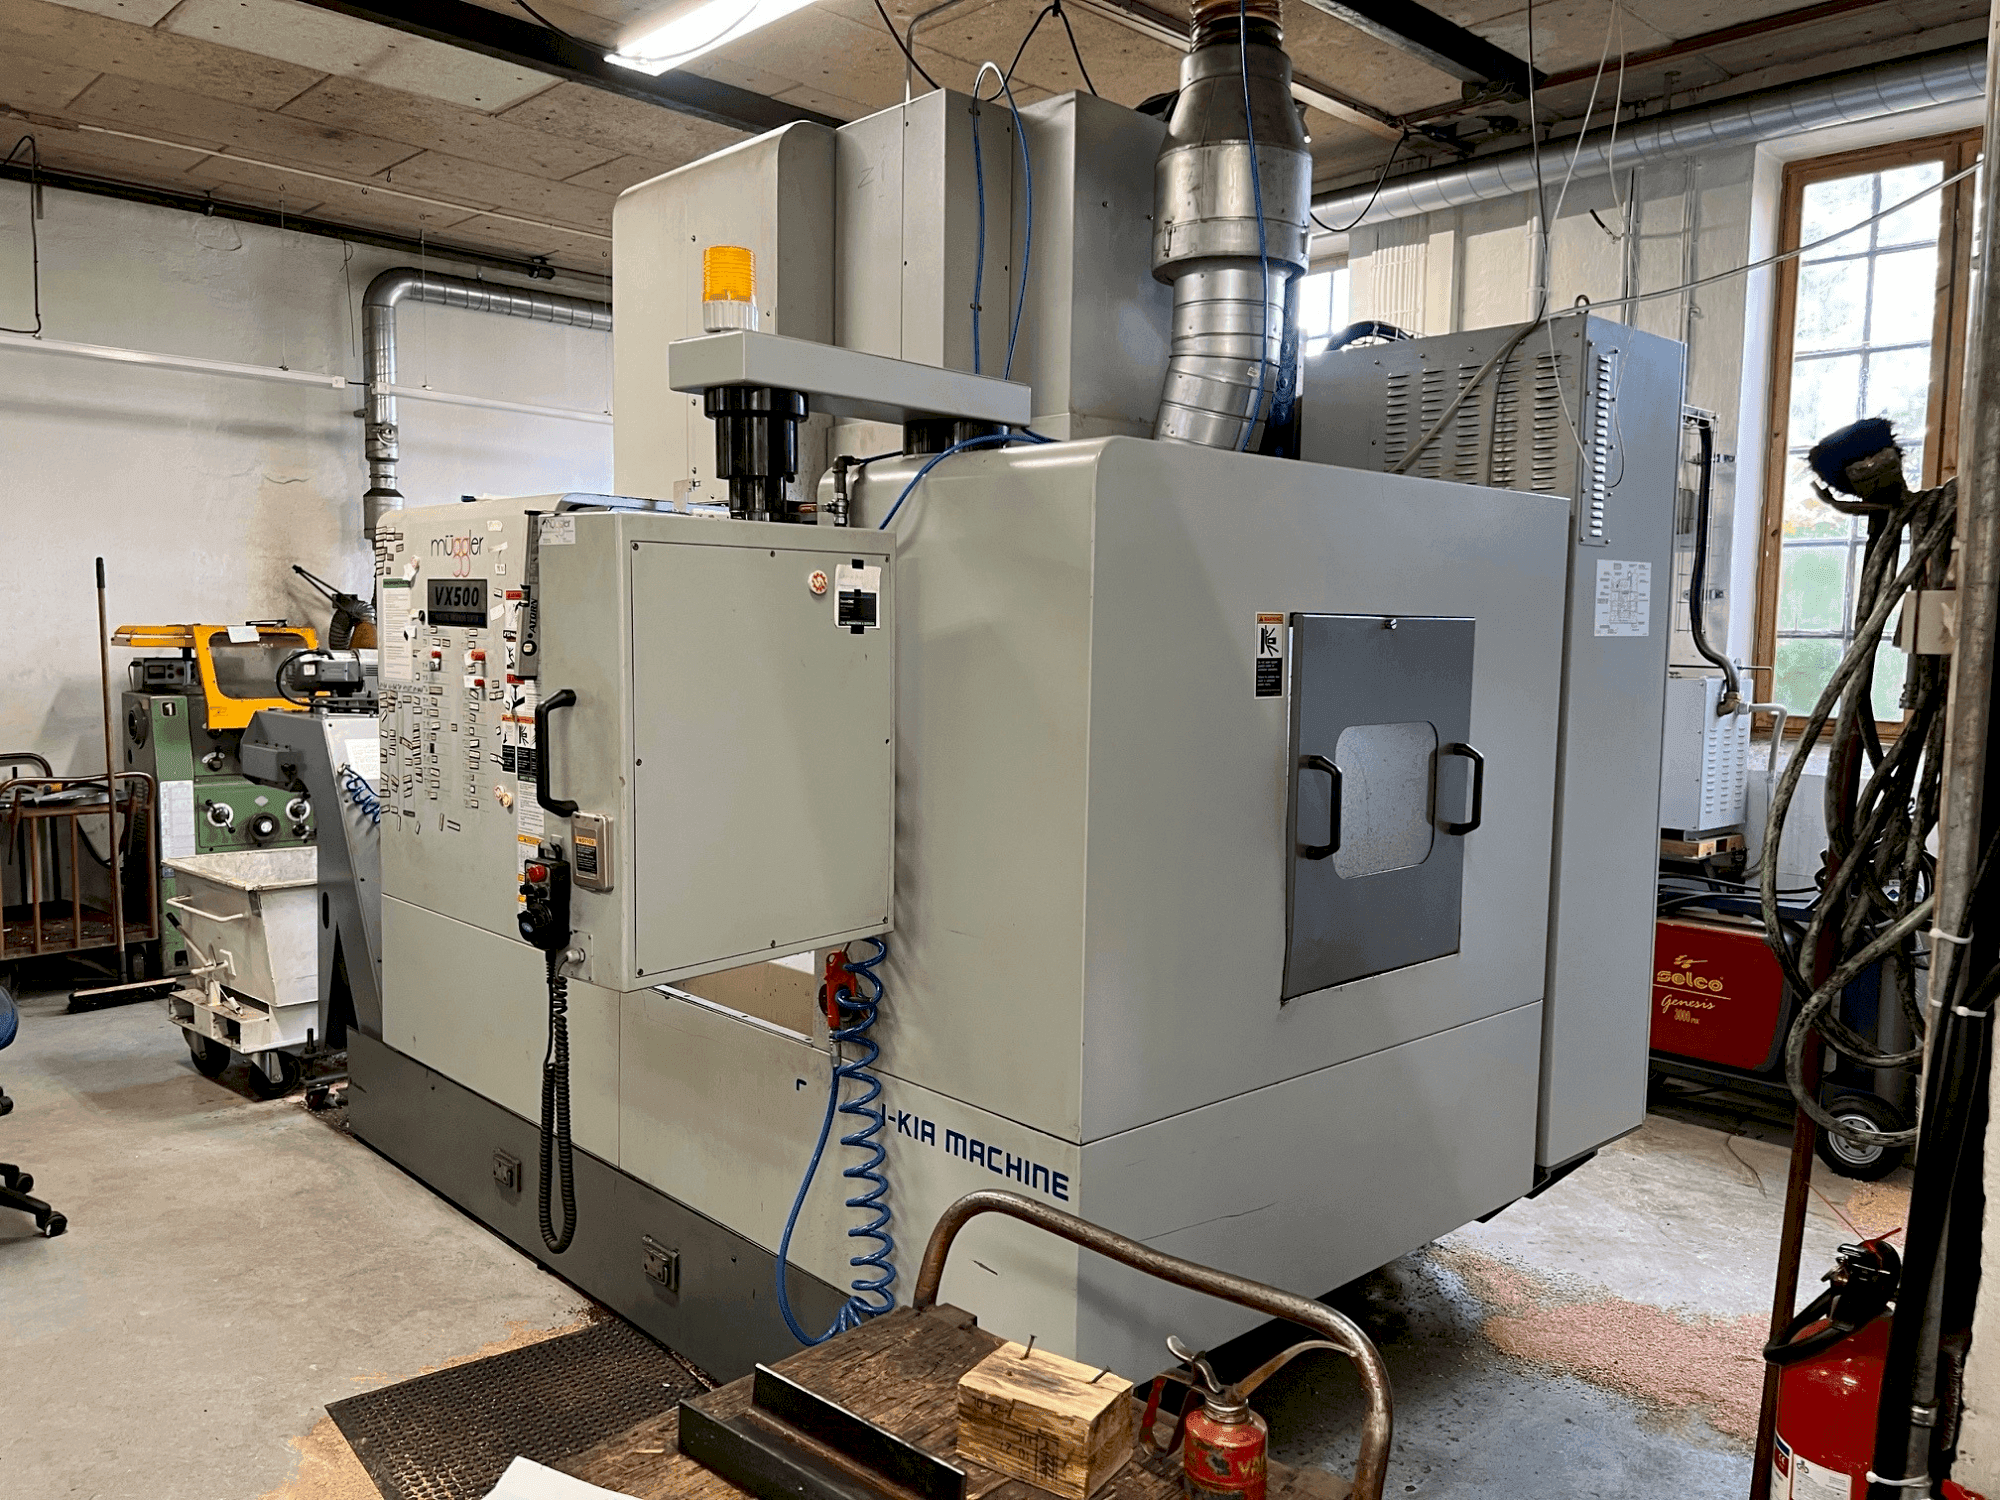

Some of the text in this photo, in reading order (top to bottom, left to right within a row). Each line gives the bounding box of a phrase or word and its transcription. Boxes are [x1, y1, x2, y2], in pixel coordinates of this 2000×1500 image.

[431, 529, 484, 577] müggler
[435, 586, 479, 607] VX500
[529, 599, 538, 634] ATORN
[1661, 994, 1716, 1014] Genesis
[946, 1128, 1069, 1202] MACHINE
